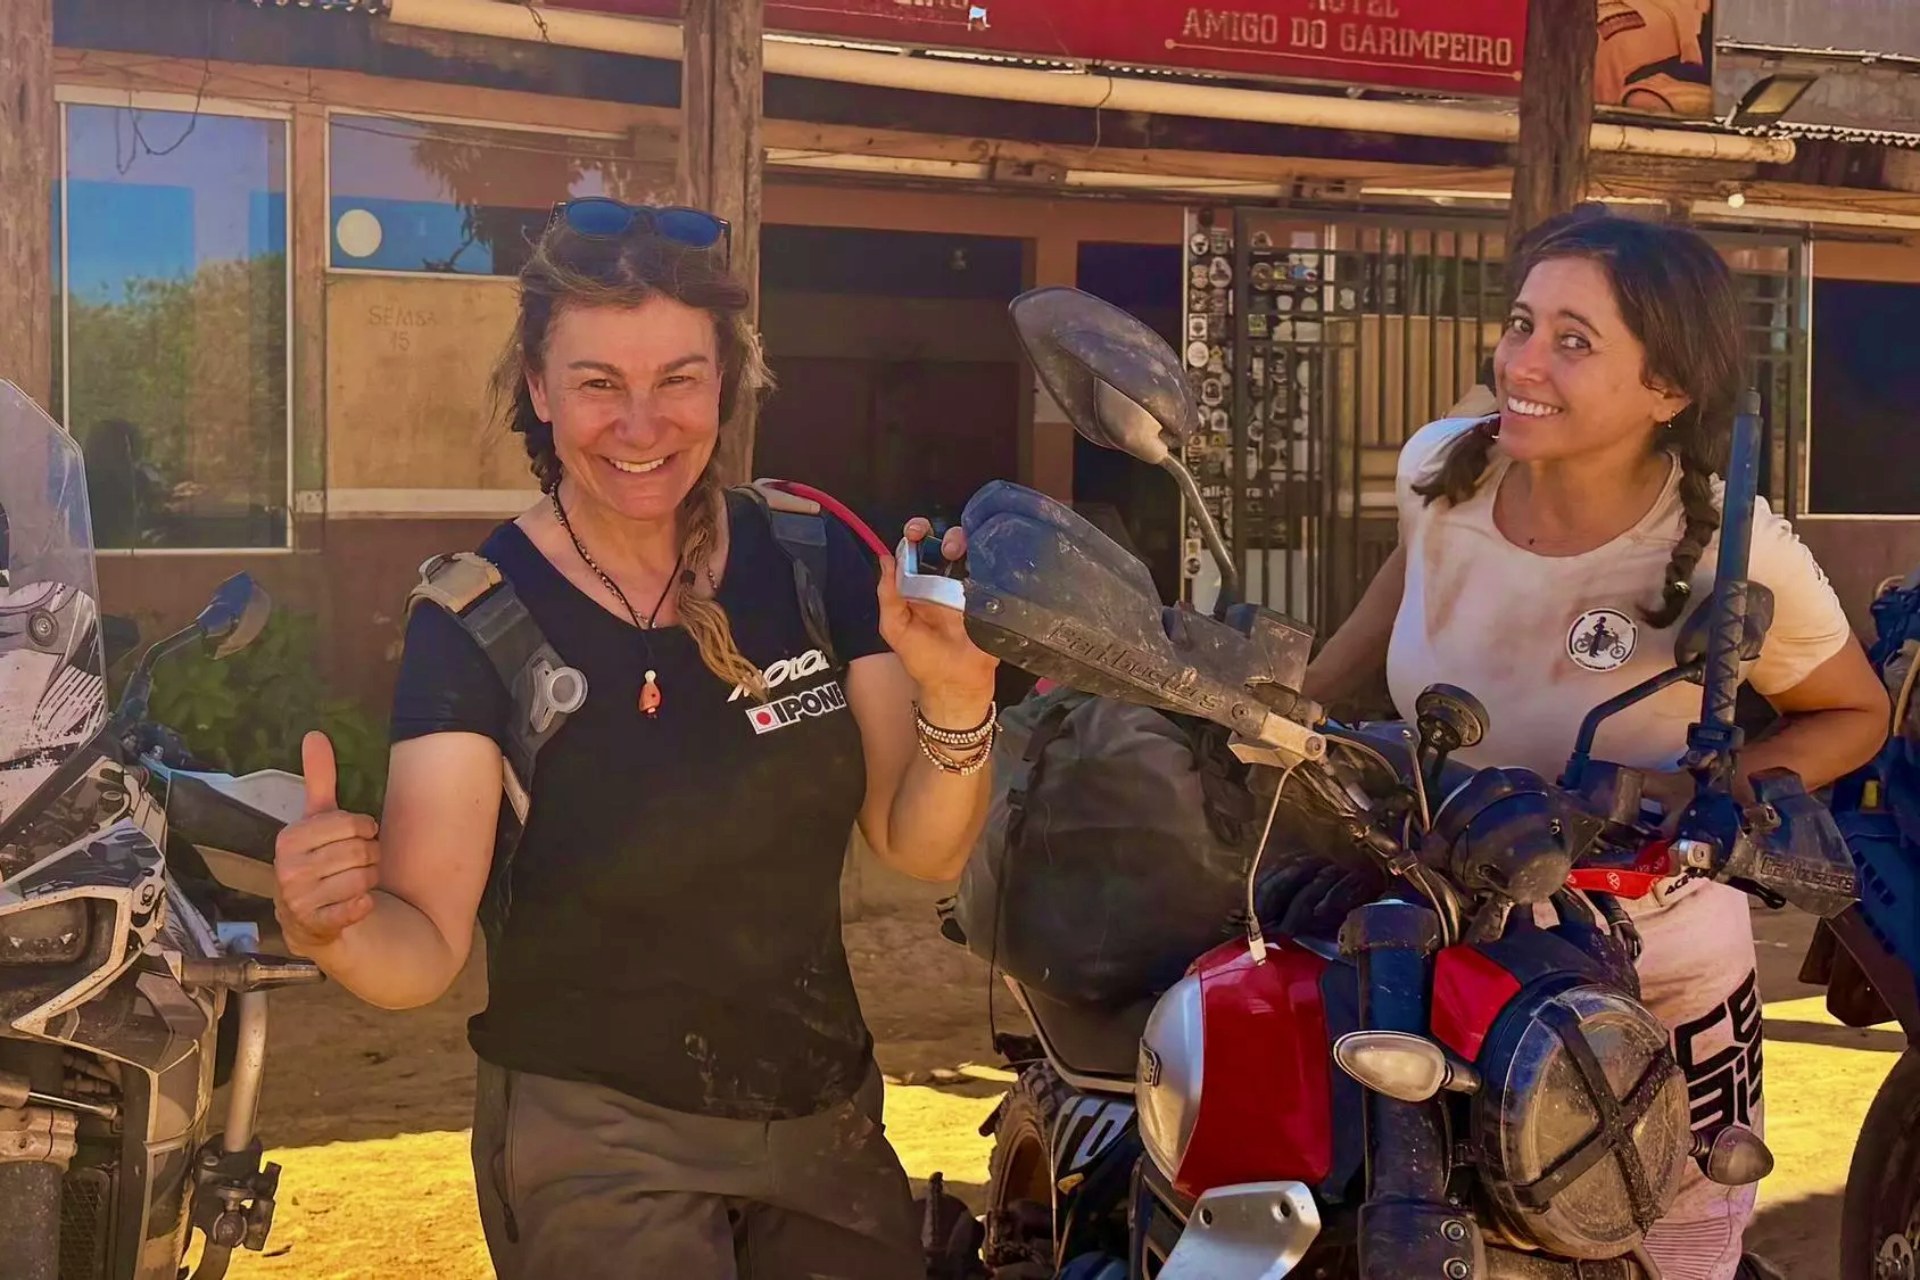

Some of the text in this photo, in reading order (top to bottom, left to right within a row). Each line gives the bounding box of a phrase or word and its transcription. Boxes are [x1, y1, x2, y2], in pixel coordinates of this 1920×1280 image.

[1183, 8, 1512, 66] AMIGO DO GARIMPEIRO
